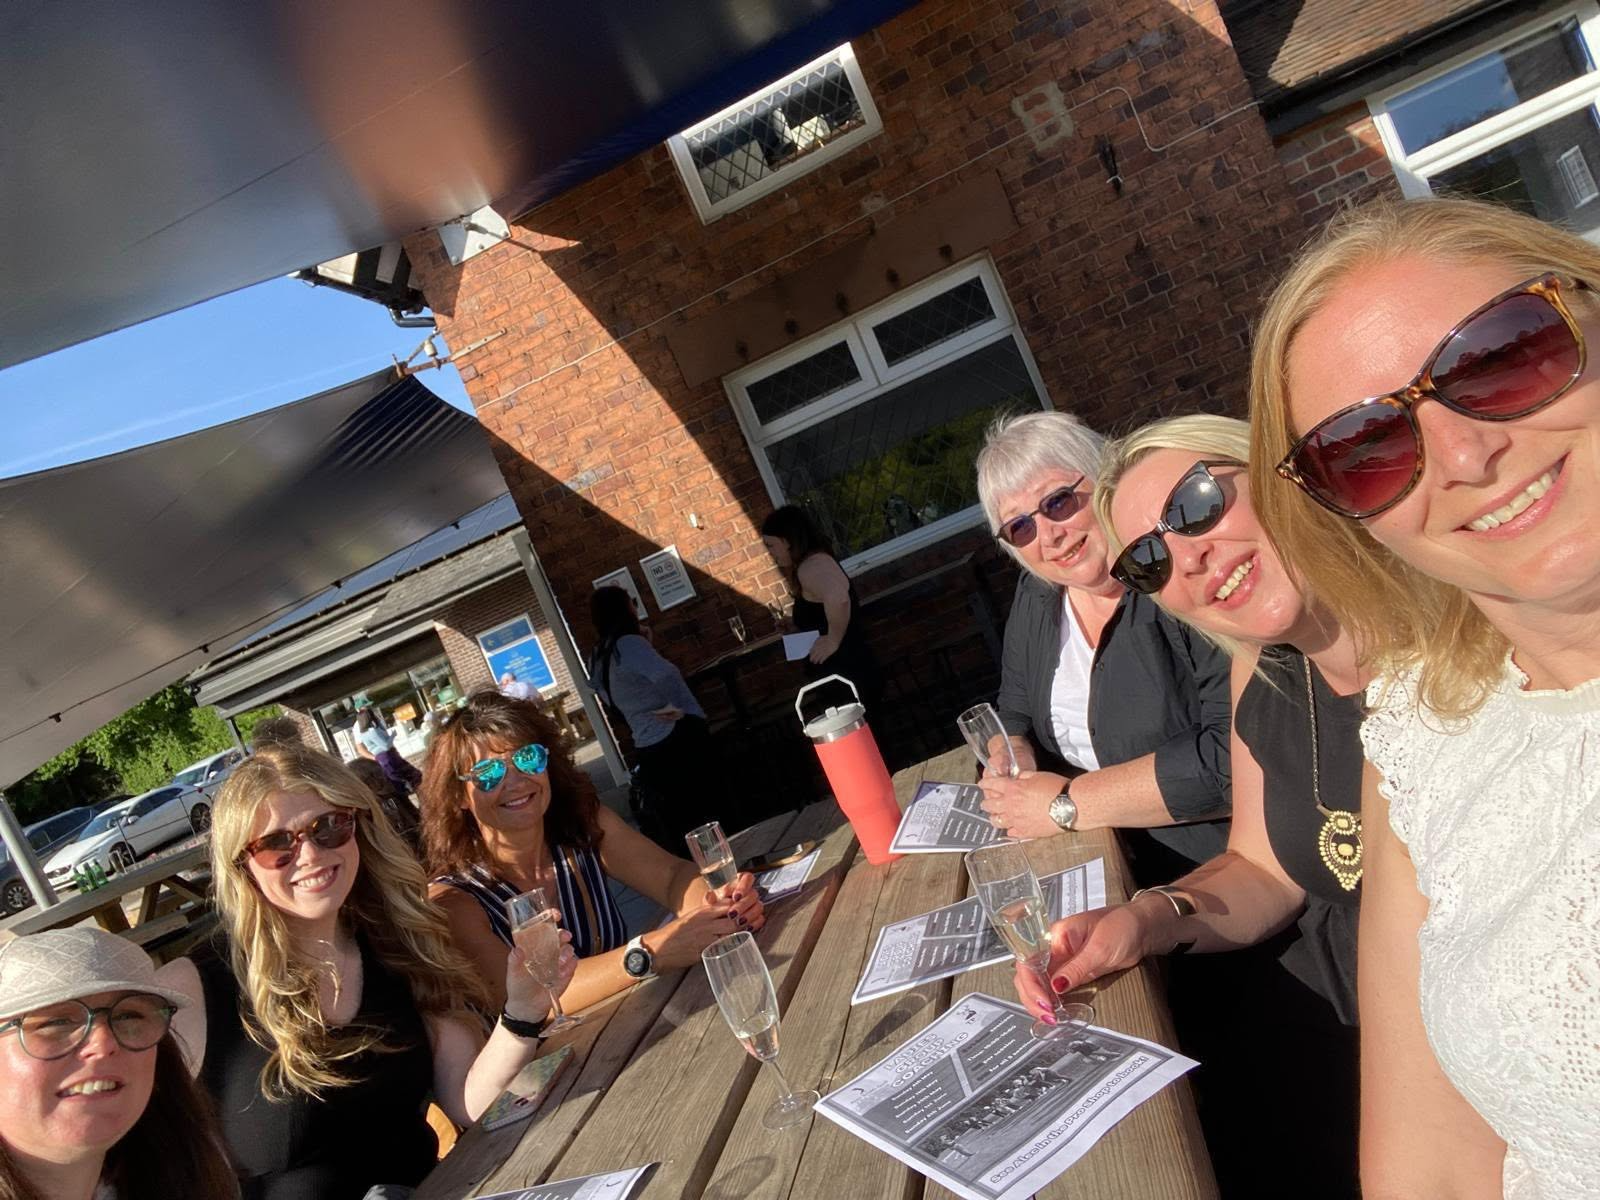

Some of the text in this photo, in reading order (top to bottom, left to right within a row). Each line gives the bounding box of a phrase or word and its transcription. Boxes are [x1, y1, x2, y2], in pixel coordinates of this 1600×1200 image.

[653, 565, 664, 576] NO
[892, 1032, 968, 1088] COACHING
[895, 1039, 945, 1073] GROUP
[990, 1055, 1150, 1184] See Alec in the Pro Shop to book!
